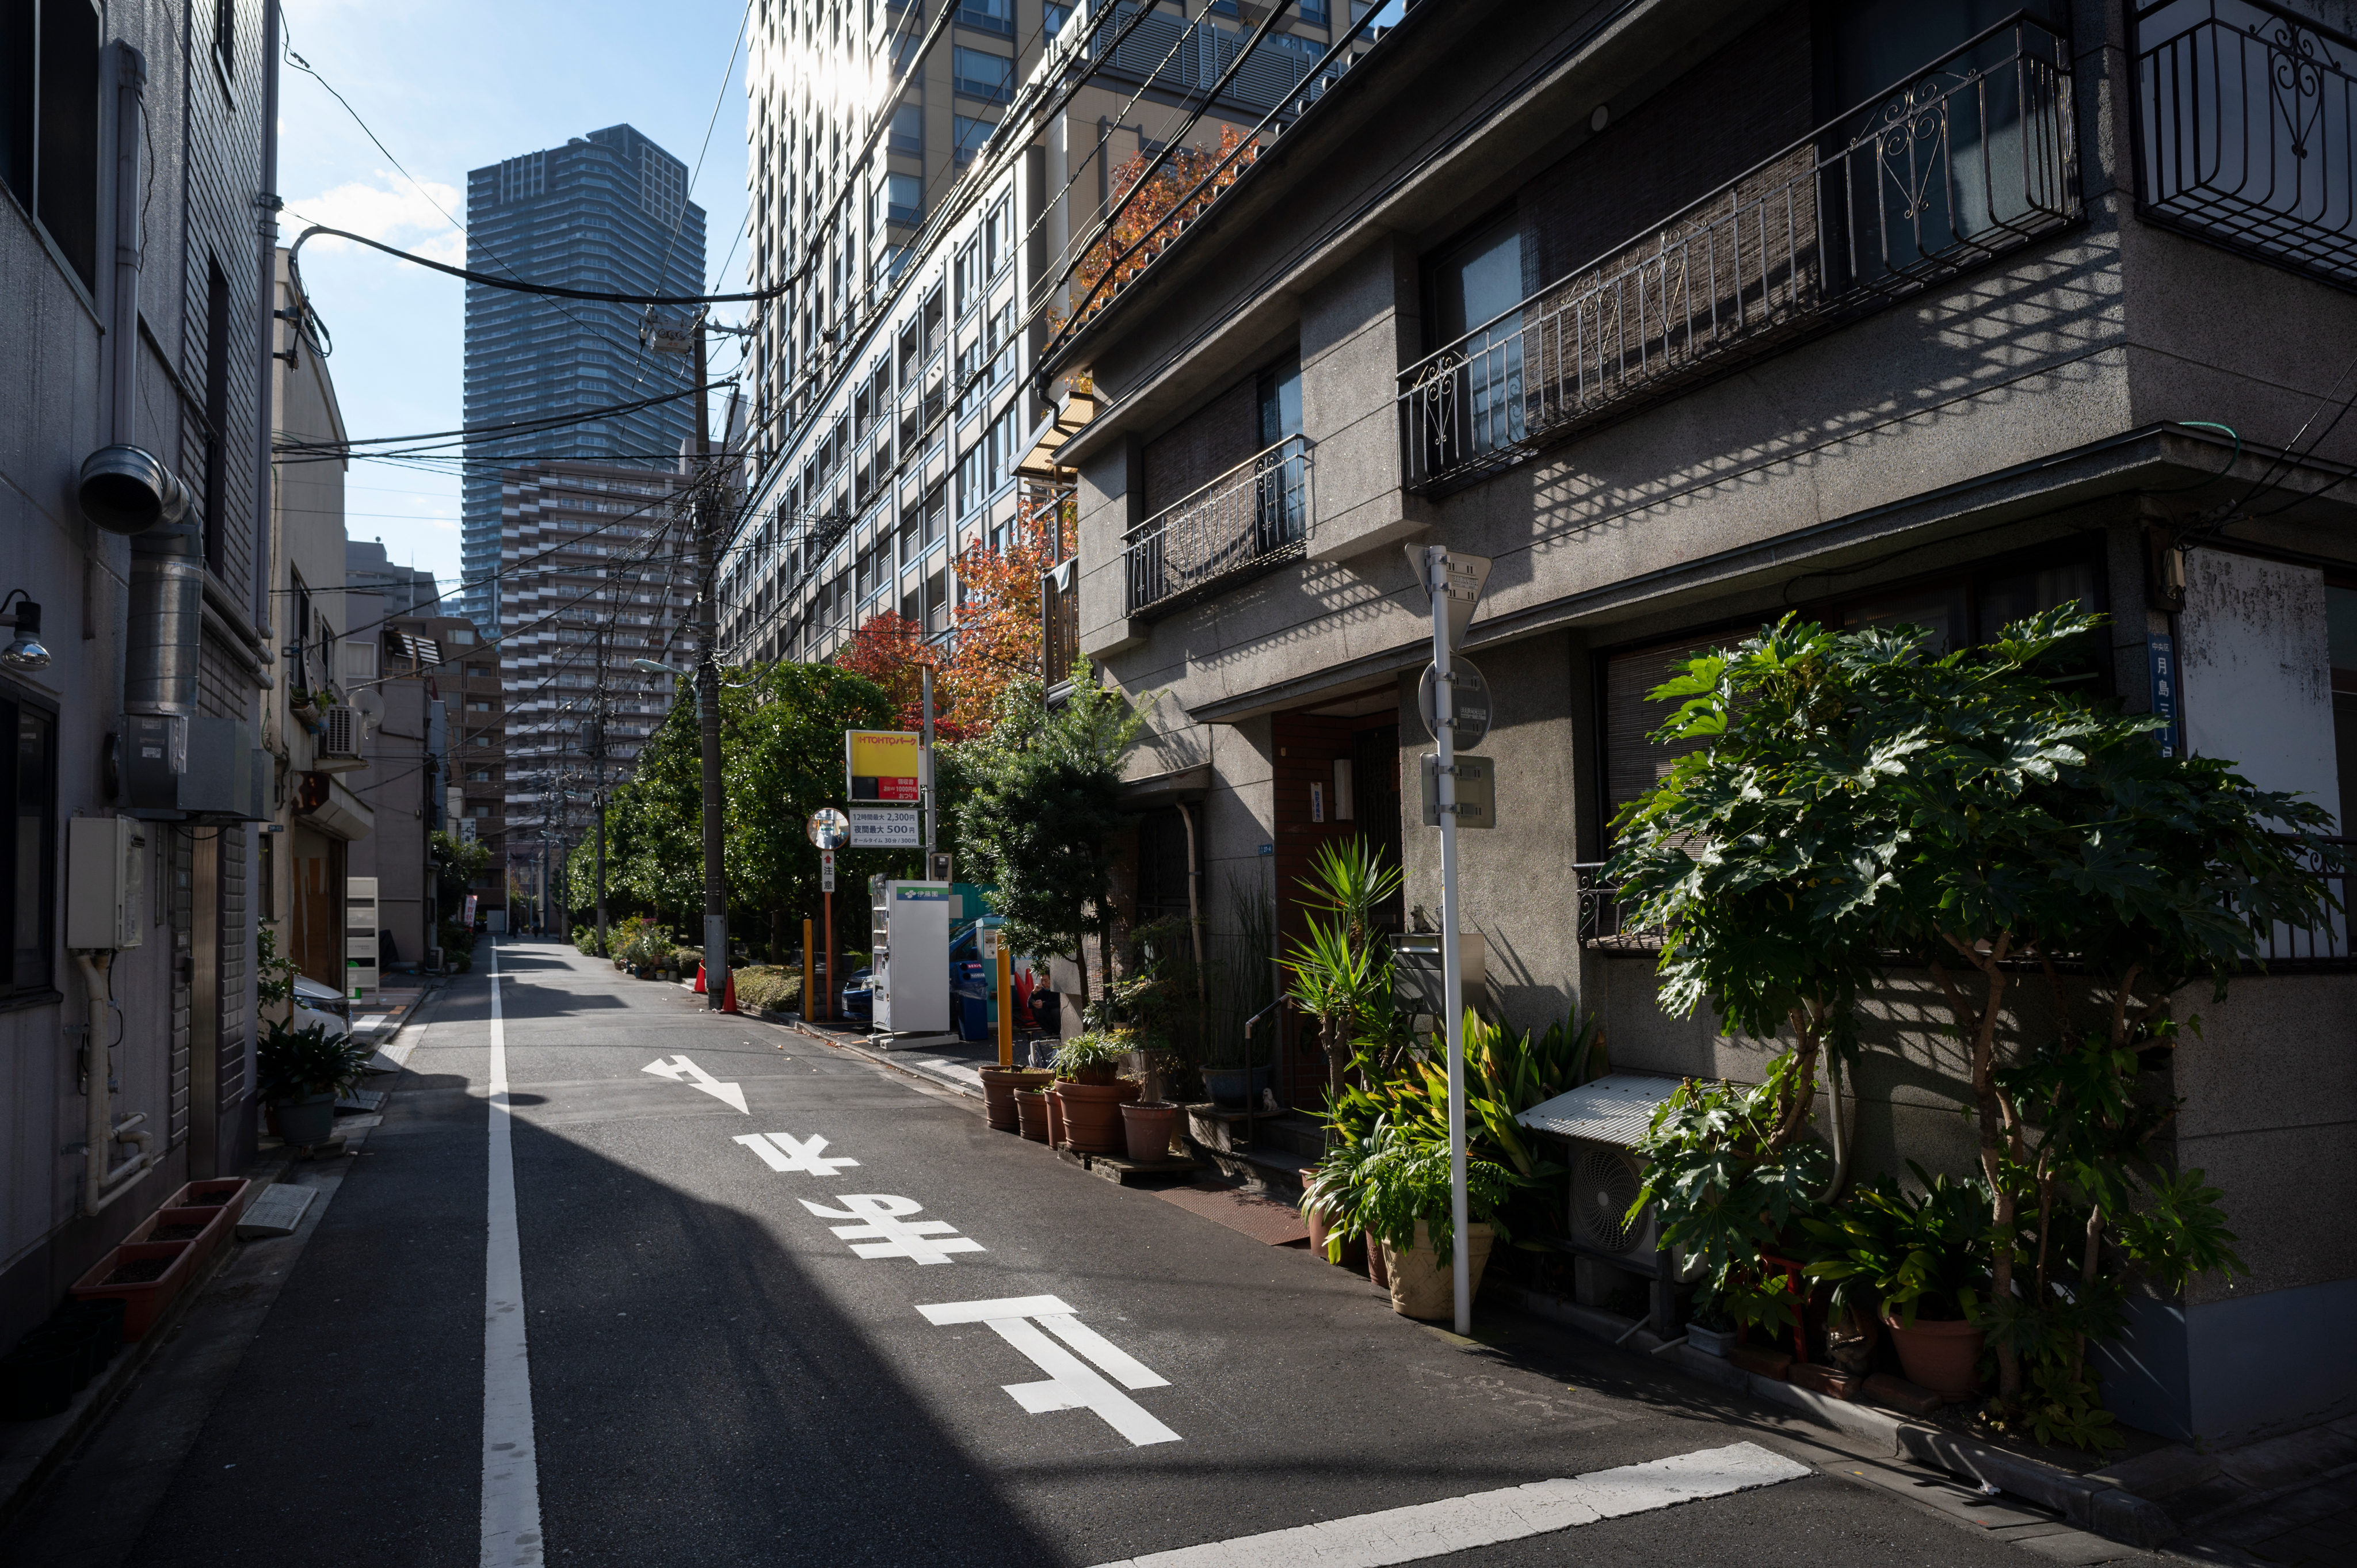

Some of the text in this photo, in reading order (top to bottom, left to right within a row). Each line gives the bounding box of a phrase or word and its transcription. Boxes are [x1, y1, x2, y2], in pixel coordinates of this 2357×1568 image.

[2152, 642, 2170, 652] 中央区
[887, 813, 915, 822] 2,300円
[854, 825, 884, 834] 夜間最大
[823, 866, 833, 889] 注意
[732, 1133, 1181, 1446] 止まれ
